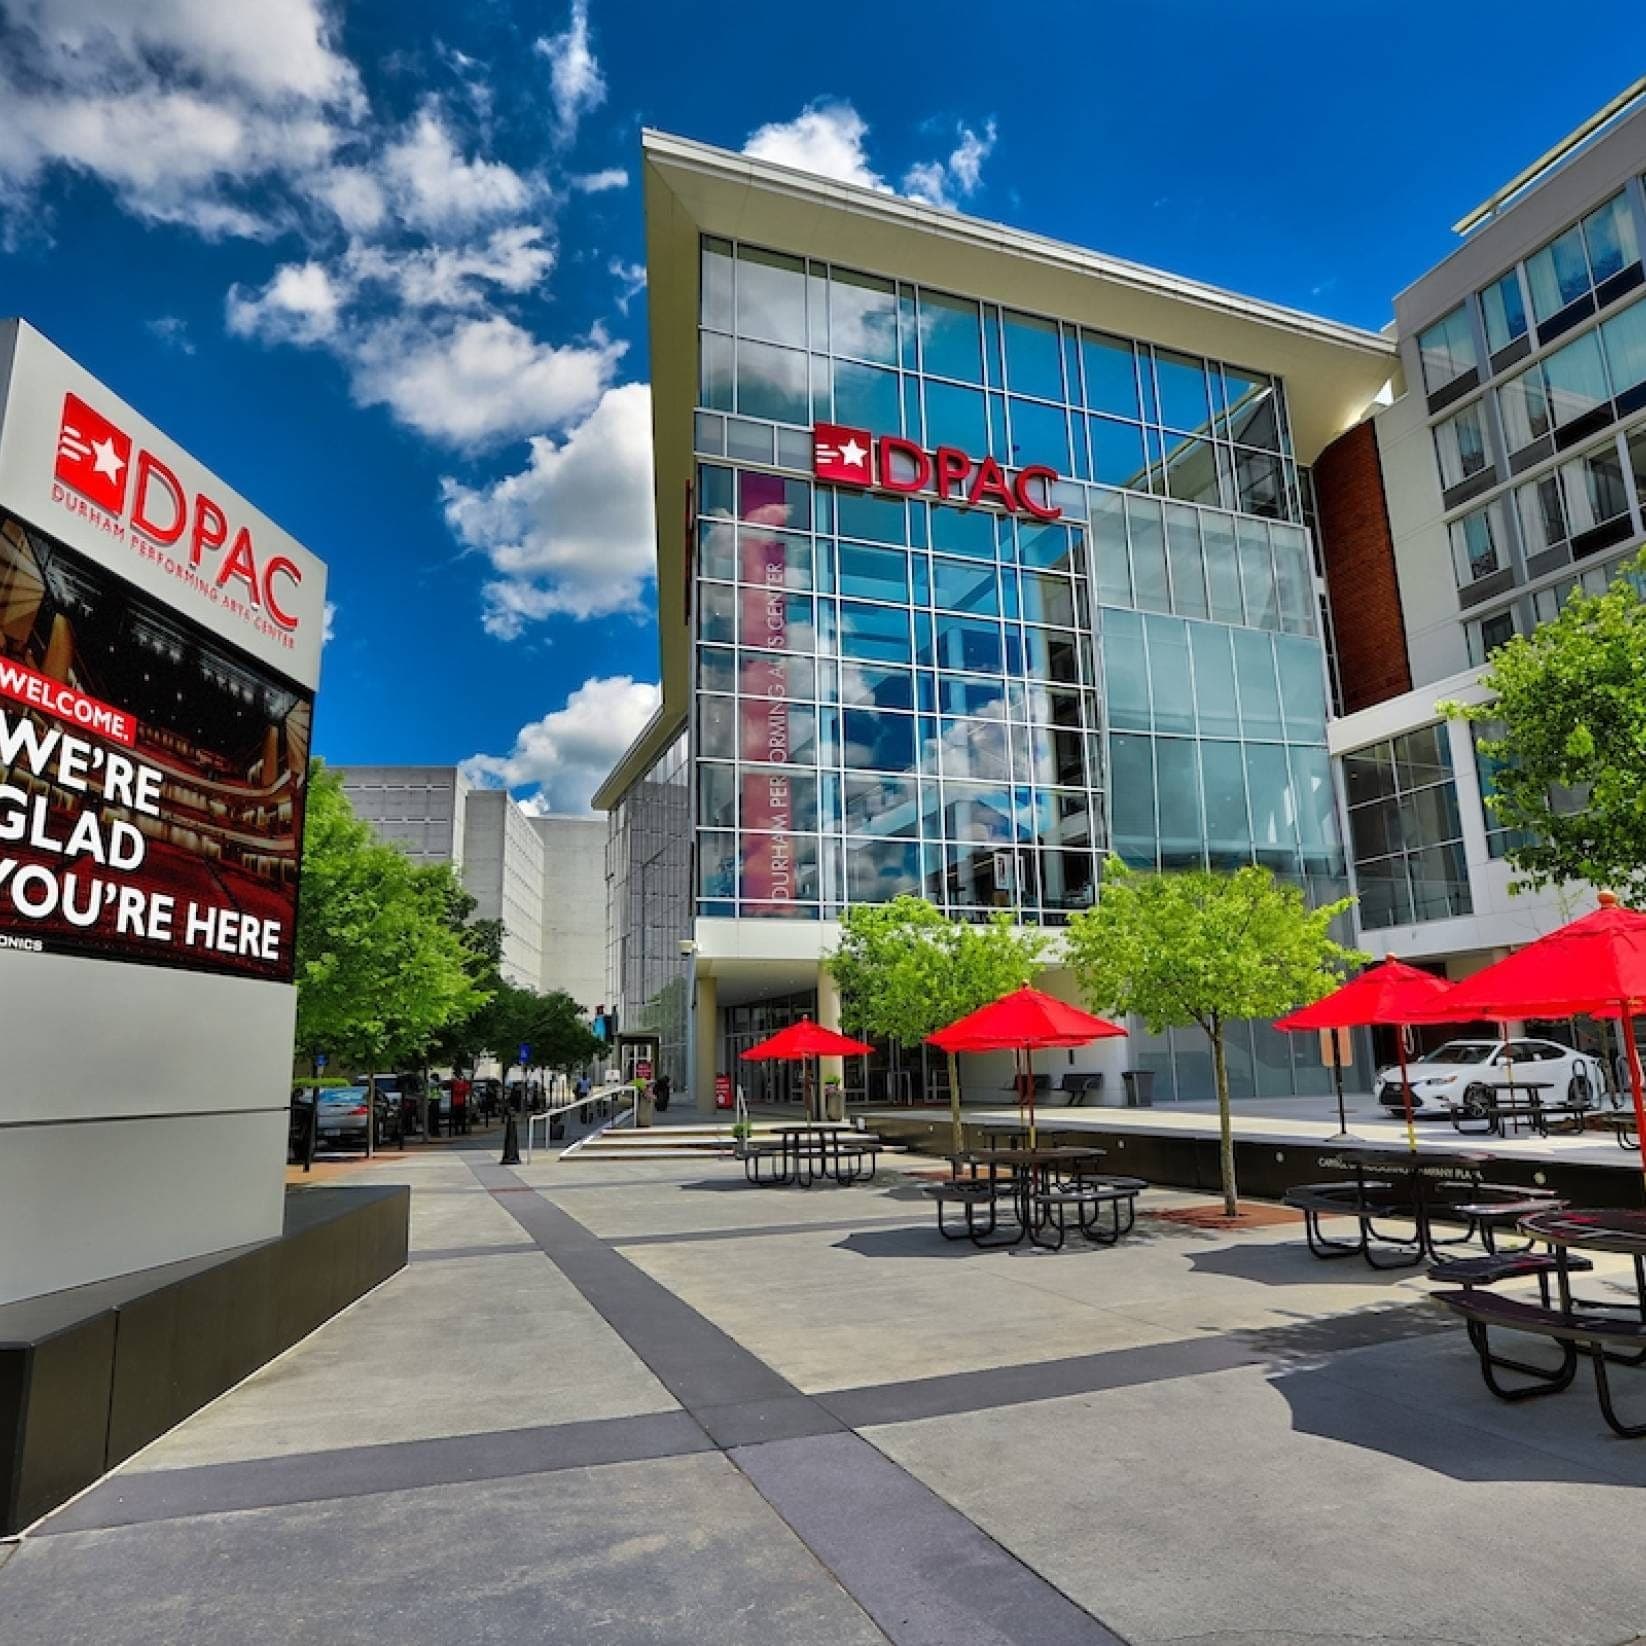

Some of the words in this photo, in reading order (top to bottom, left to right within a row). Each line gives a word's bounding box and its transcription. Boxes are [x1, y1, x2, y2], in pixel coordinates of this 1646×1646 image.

[879, 436, 1062, 518] DPAC
[51, 484, 126, 542] DURHAM
[129, 534, 218, 602] PERFORMING
[222, 595, 252, 623] ARTS
[254, 615, 295, 648] CENTER
[130, 449, 302, 631] DPAC
[766, 563, 784, 631] CENTER
[767, 636, 786, 675] AS
[0, 663, 129, 741] WELCOME.
[768, 684, 788, 806] PERORMING
[0, 710, 162, 816] WE'RE
[0, 784, 145, 870] GLAD
[771, 814, 789, 900] DURHAM
[185, 901, 281, 960] HERE
